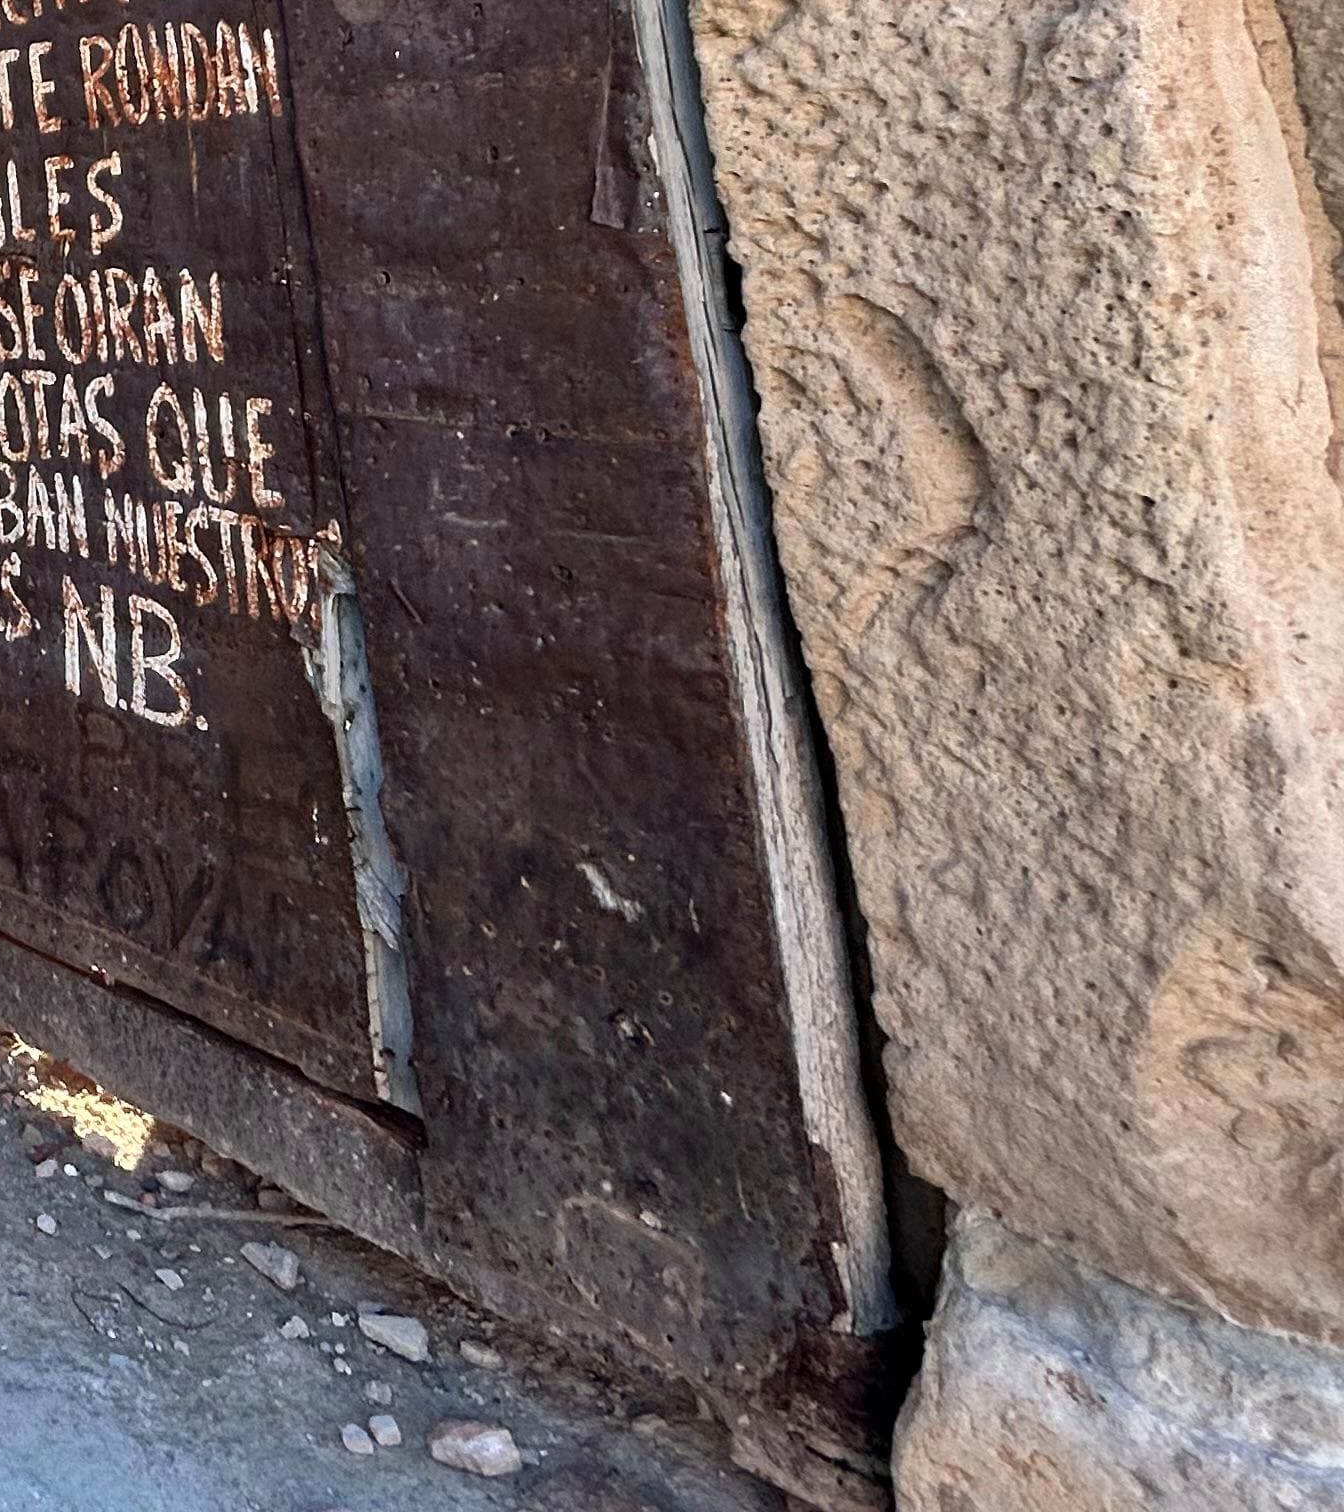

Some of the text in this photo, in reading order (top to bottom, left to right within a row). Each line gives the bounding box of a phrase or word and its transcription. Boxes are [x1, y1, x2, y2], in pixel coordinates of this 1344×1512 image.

[79, 19, 282, 130] RONDAN
[54, 266, 226, 366] OIRAN
[146, 381, 286, 508] QUE
